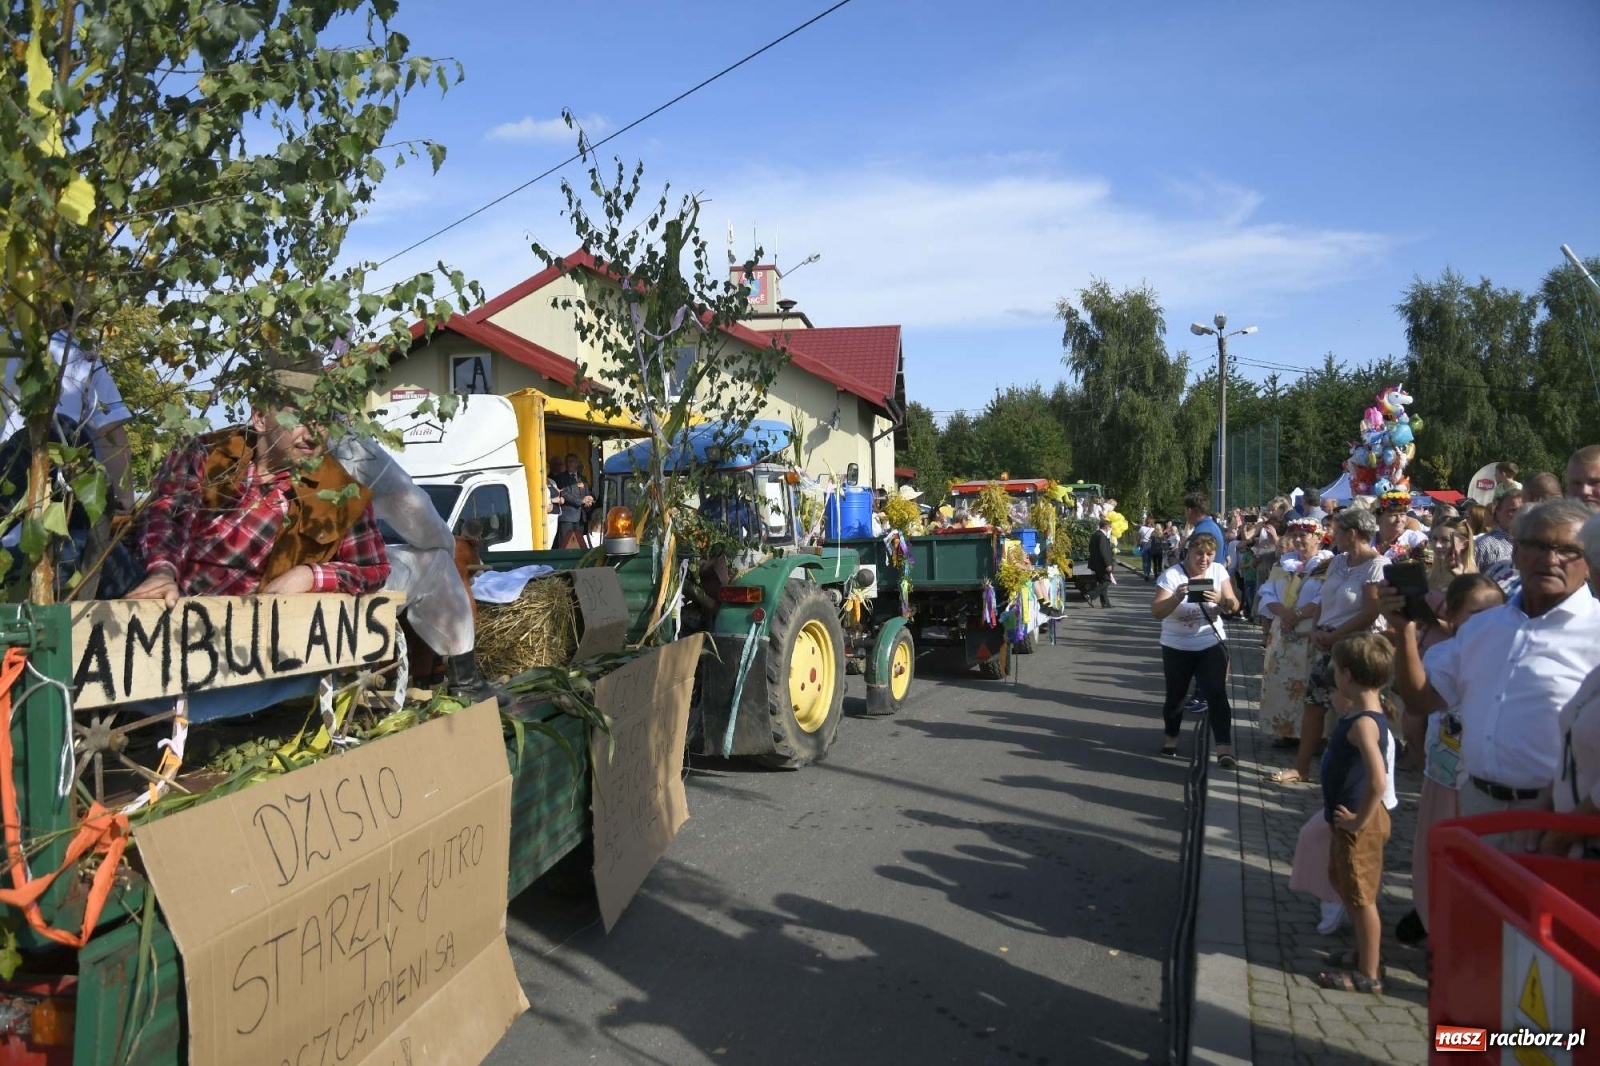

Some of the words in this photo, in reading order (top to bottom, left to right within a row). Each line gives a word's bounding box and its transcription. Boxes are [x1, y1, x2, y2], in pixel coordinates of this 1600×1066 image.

[72, 596, 392, 703] AMBULANS
[253, 766, 403, 887] DZISIO
[233, 869, 404, 1035] STARZIK
[417, 824, 484, 923] JUTRO
[348, 926, 398, 991] TY
